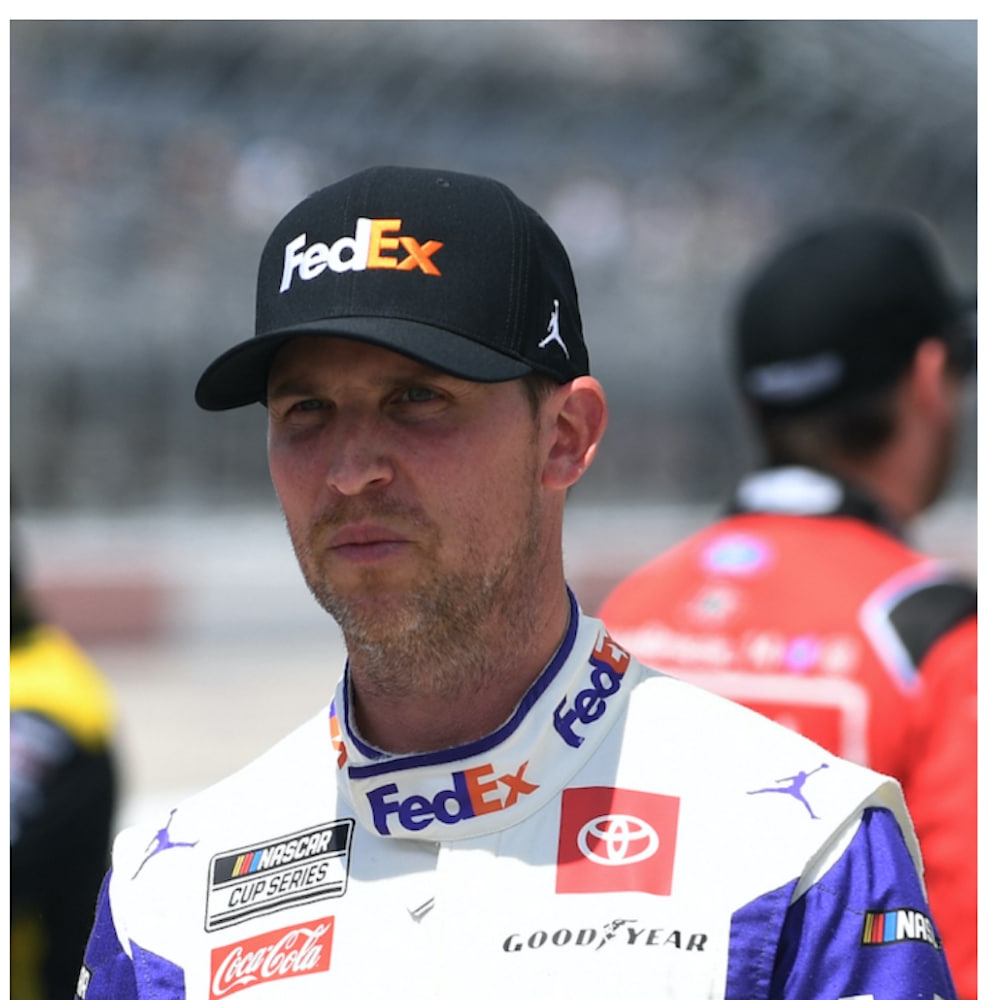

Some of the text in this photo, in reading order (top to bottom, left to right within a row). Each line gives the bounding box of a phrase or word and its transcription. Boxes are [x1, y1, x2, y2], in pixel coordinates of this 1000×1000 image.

[279, 217, 444, 293] FedEx
[366, 760, 540, 835] FedEx
[257, 830, 333, 871] NASCAR
[228, 862, 329, 908] CUP SERIES
[212, 922, 331, 996] Coca-Cola
[896, 909, 940, 949] NAS
